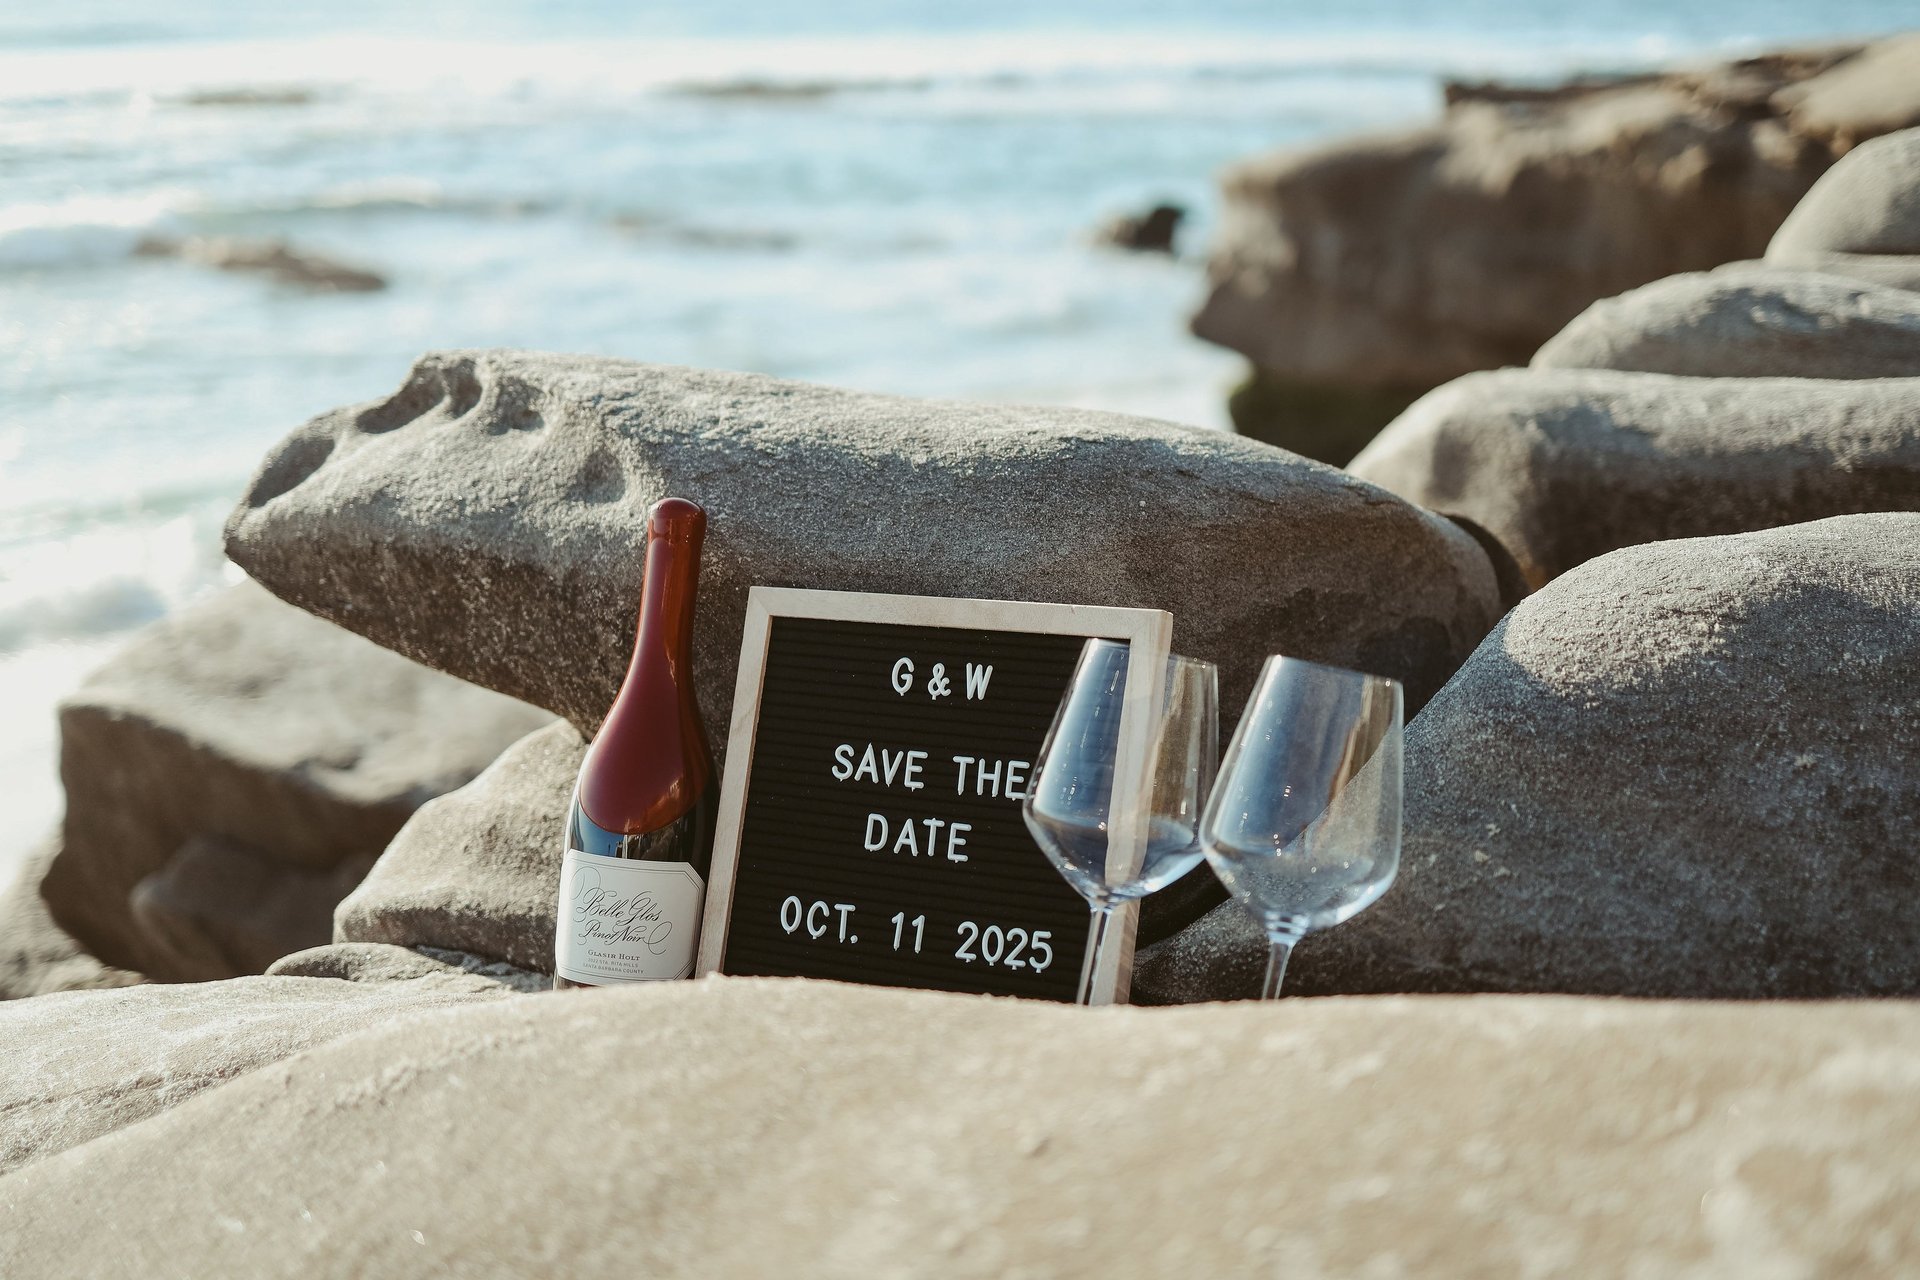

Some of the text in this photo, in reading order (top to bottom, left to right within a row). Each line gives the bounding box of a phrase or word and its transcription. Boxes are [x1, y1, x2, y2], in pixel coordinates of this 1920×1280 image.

[891, 657, 994, 701] G & W
[831, 743, 1030, 801] SAVE THE
[864, 813, 972, 863] DATE
[572, 872, 662, 926] Belle Glos
[579, 920, 617, 945] Pinot
[780, 895, 1053, 974] OCT. 11 2025
